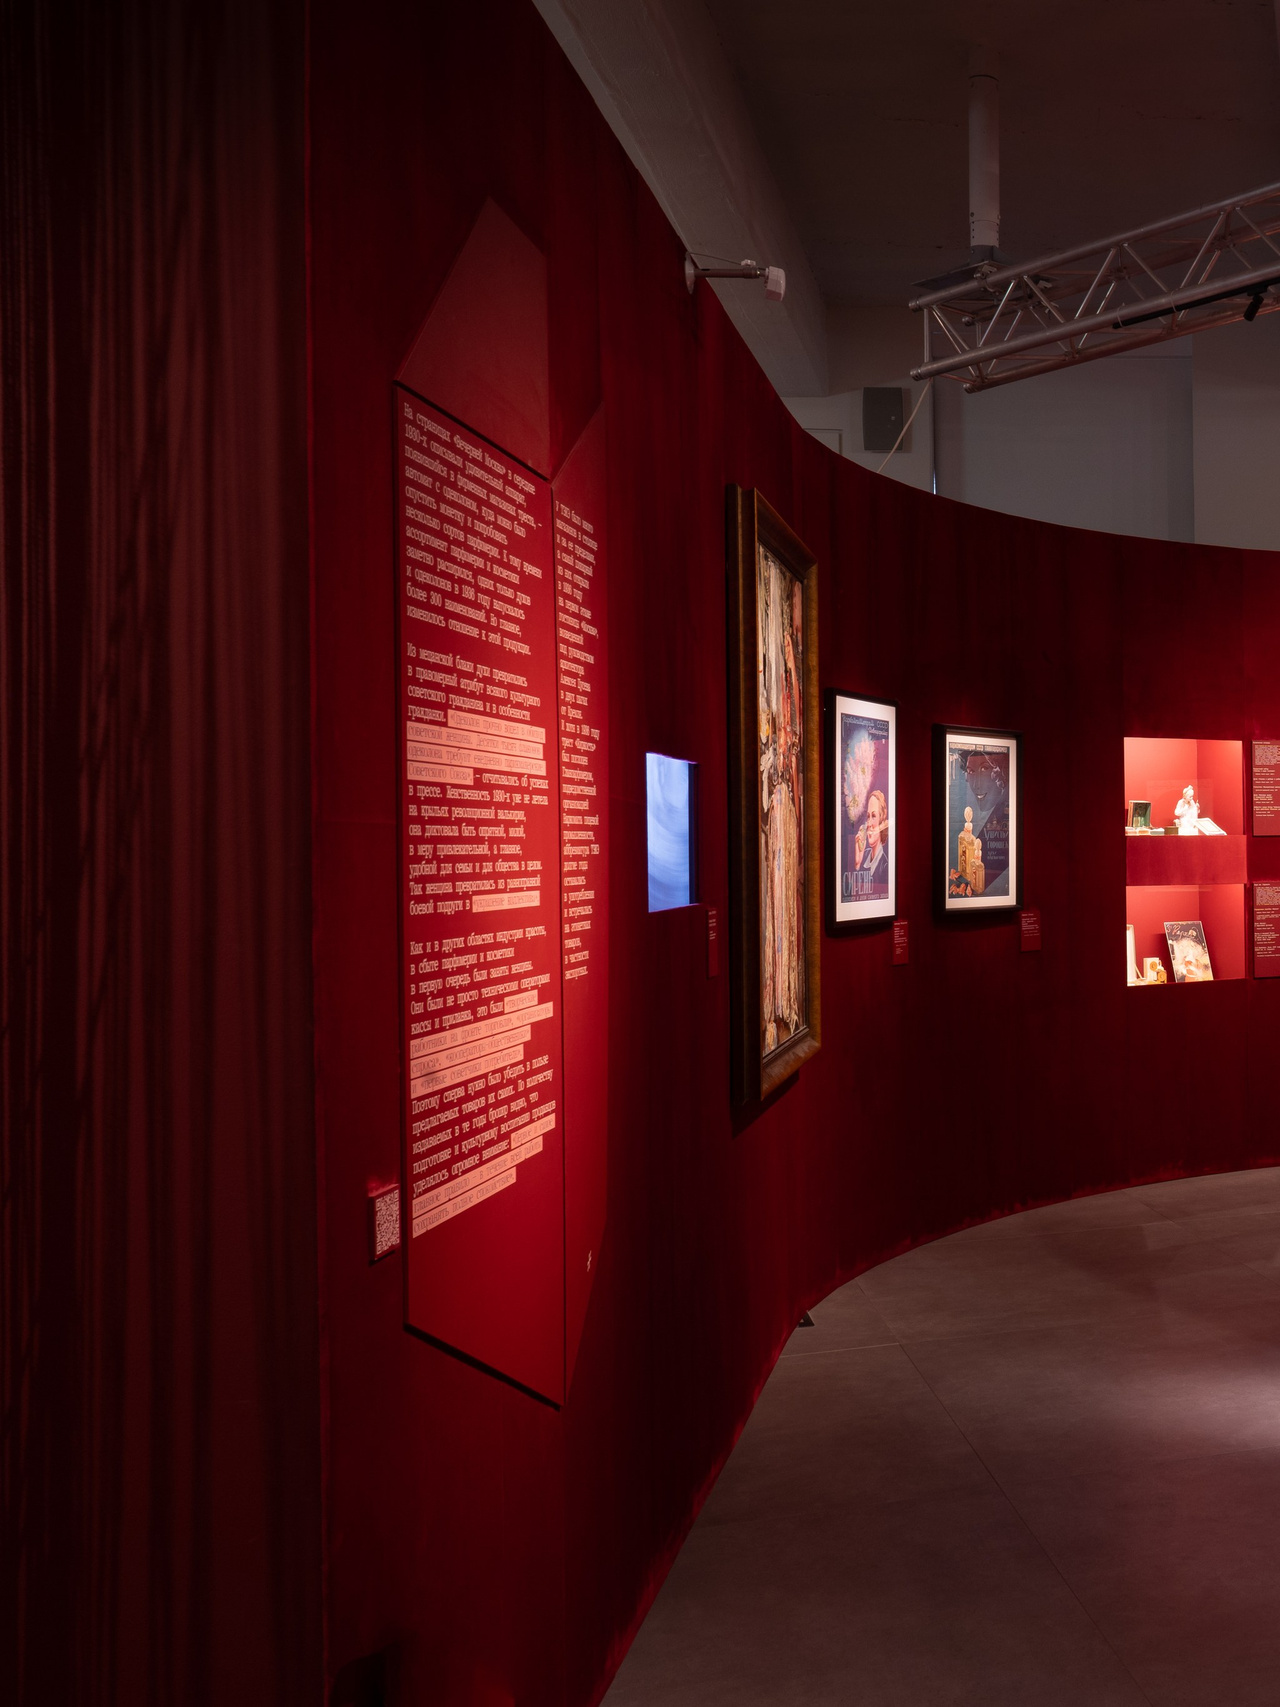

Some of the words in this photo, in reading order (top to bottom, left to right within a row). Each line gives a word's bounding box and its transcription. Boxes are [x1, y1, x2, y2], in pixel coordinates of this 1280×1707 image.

[404, 402, 413, 420] На
[416, 412, 450, 443] страницах
[405, 422, 427, 448] 1930-х
[430, 440, 462, 468] описывали
[404, 445, 447, 478] появившийся
[450, 471, 454, 482] в
[405, 465, 432, 489] автомат
[435, 482, 440, 493] с
[405, 485, 436, 510] опустить
[439, 503, 464, 527] монетку
[405, 505, 440, 531] несколько
[443, 523, 464, 542] сортов
[406, 525, 447, 553] ассортимент
[406, 545, 433, 566] заметно
[406, 565, 411, 577] и
[454, 584, 458, 595] в
[406, 582, 426, 602] более
[430, 590, 441, 607] 300
[407, 605, 445, 628] изменилось
[407, 641, 416, 657] Из
[419, 648, 453, 668] мещанской
[407, 664, 412, 676] в
[407, 684, 445, 703] советского
[408, 704, 446, 722] гражданки.
[408, 761, 446, 780] Советского
[408, 784, 413, 796] в
[416, 785, 442, 800] прессе.
[408, 804, 417, 816] на
[421, 805, 448, 819] крыльях
[408, 824, 421, 836] она
[424, 825, 458, 839] диктовала
[409, 844, 414, 855] в
[417, 844, 433, 858] меру
[409, 860, 437, 879] удобной
[440, 863, 452, 877] для
[409, 880, 422, 895] Так
[425, 882, 452, 896] женщина
[843, 871, 873, 896] СИРЕНЬ
[409, 899, 433, 915] боевой
[437, 900, 462, 915] подруги
[410, 940, 423, 955] Как
[426, 942, 431, 953] и
[434, 940, 438, 952] в
[441, 937, 464, 954] других
[410, 964, 415, 975] в
[418, 958, 438, 974] сбыте
[410, 984, 415, 995] в
[419, 978, 442, 995] первую
[445, 973, 470, 989] очередь
[410, 1000, 423, 1015] Они
[426, 996, 443, 1012] были
[446, 995, 454, 1007] не
[411, 1020, 431, 1035] кассы
[434, 1018, 439, 1029] и
[442, 1010, 473, 1029] прилавка,
[412, 1094, 440, 1115] Поэтому
[443, 1085, 464, 1103] сперва
[412, 1106, 459, 1137] предлагаемых
[412, 1128, 452, 1155] издаваемых
[454, 1125, 459, 1137] в
[413, 1147, 451, 1175] подготовке
[454, 1144, 458, 1156] и
[413, 1168, 448, 1198] уделялось
[451, 1153, 479, 1176] огромное
